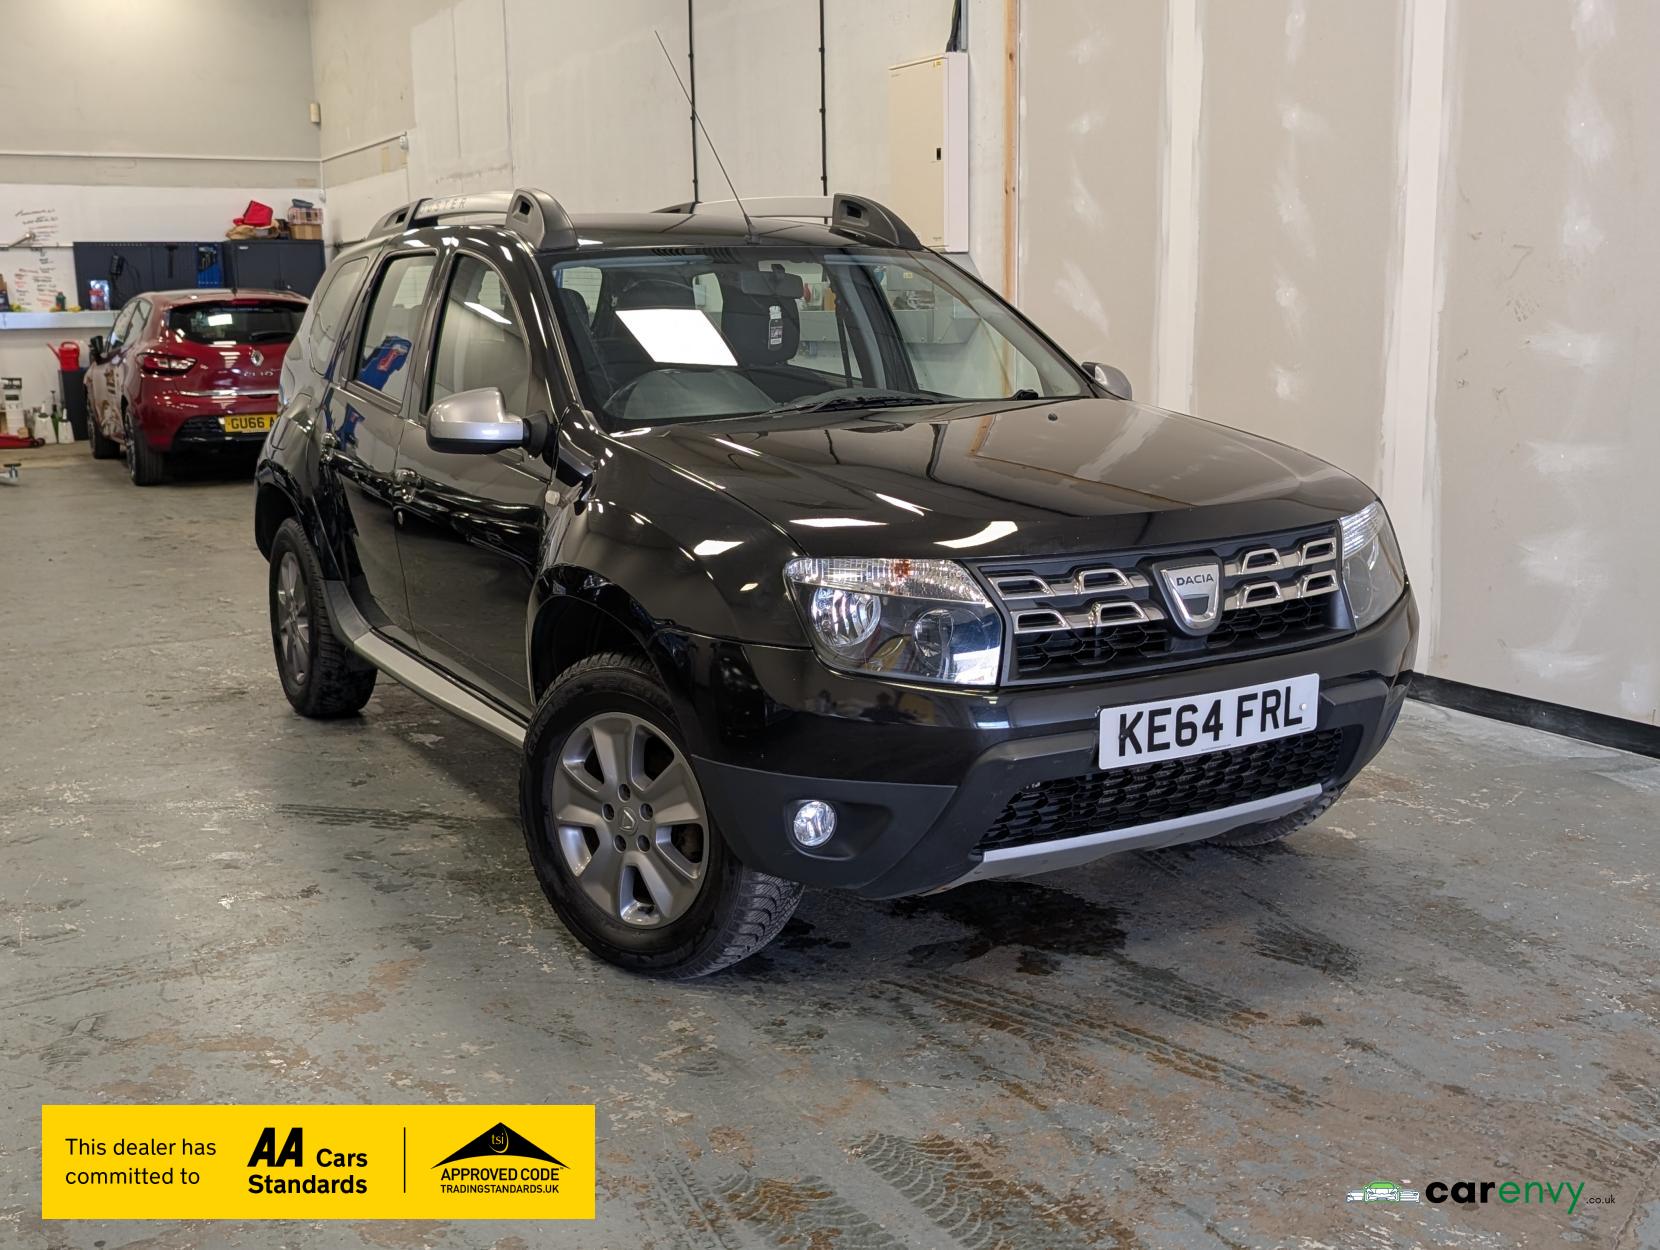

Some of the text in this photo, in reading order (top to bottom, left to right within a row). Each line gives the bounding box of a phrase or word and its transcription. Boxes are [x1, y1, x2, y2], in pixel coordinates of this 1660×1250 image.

[231, 417, 265, 429] GU66
[1177, 573, 1214, 586] DACIA
[1118, 686, 1303, 757] KE64 FRL
